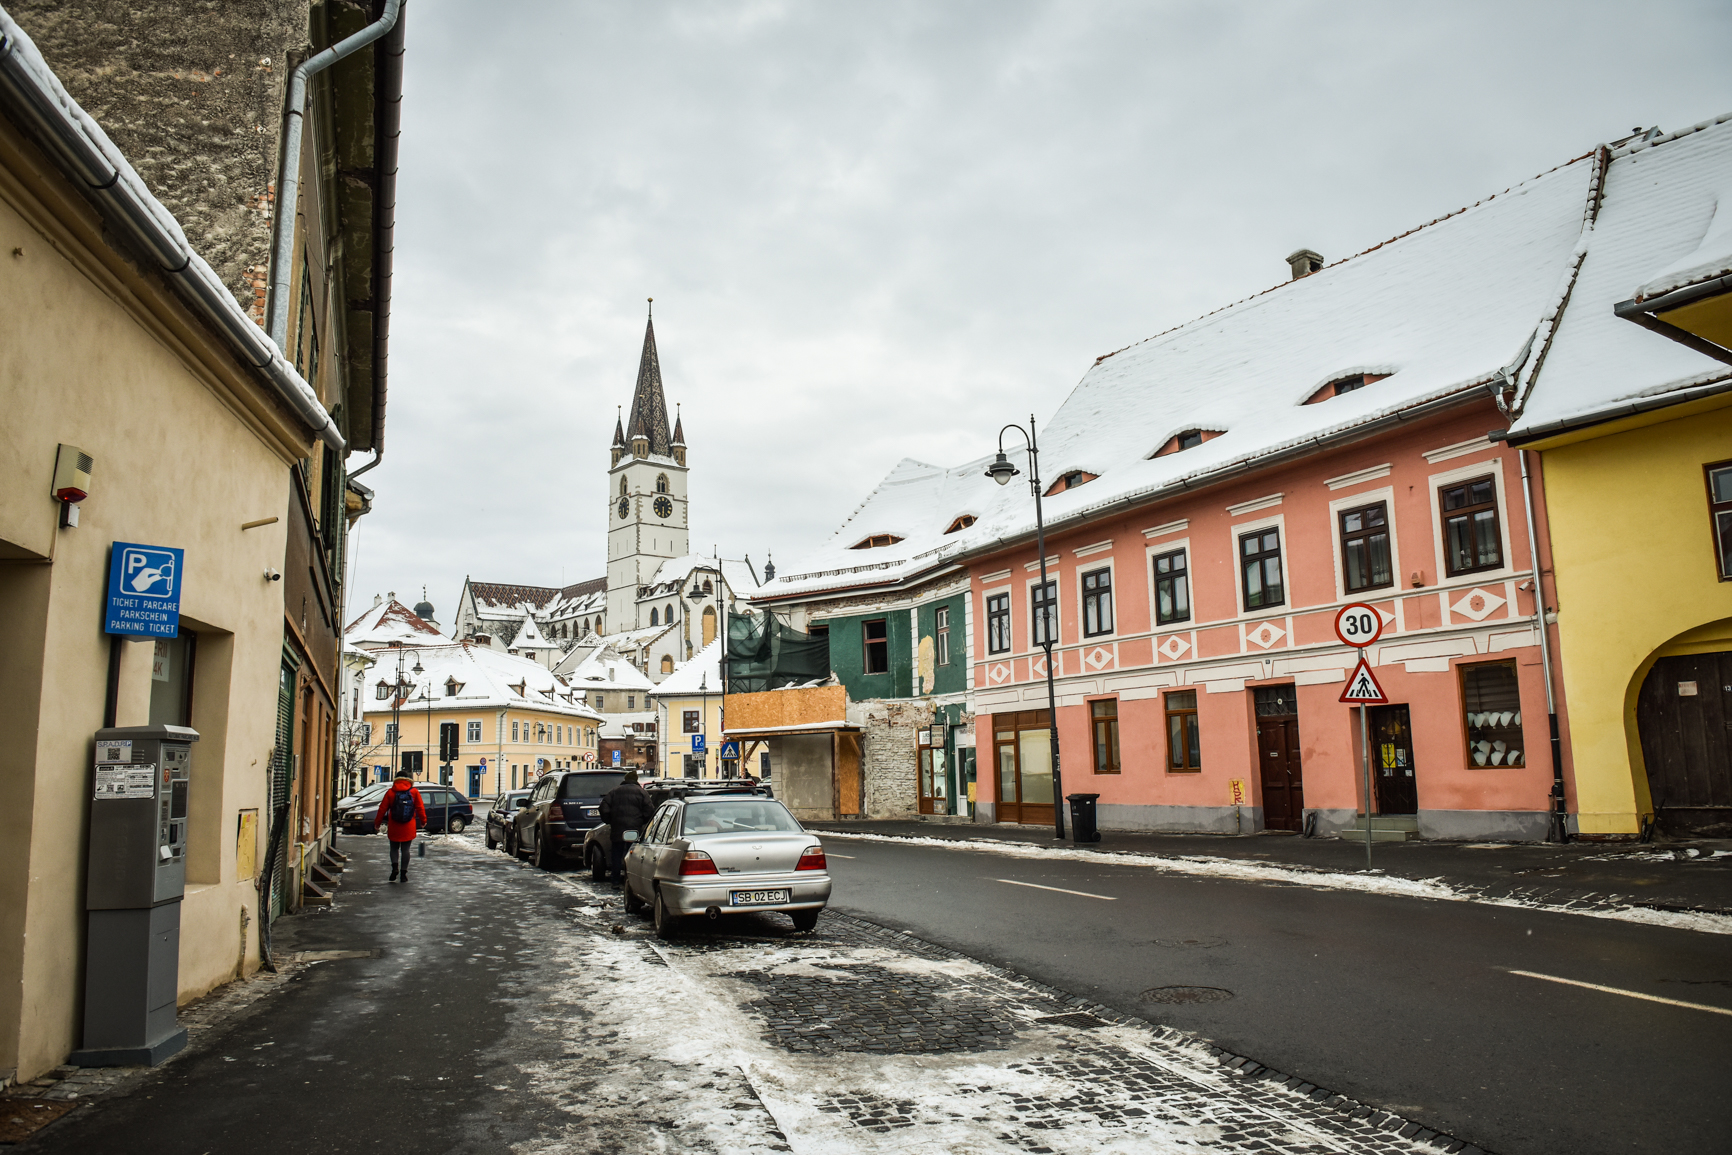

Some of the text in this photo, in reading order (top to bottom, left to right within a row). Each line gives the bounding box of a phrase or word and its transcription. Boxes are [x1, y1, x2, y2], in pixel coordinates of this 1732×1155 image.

[128, 553, 147, 574] P
[112, 597, 177, 612] TICHET PARCARE
[120, 610, 168, 622] PARKSCHEIN
[110, 620, 175, 634] PARKING TICKET
[1345, 614, 1373, 635] 30
[695, 736, 702, 746] P
[738, 890, 786, 903] SB 02 ECJ
